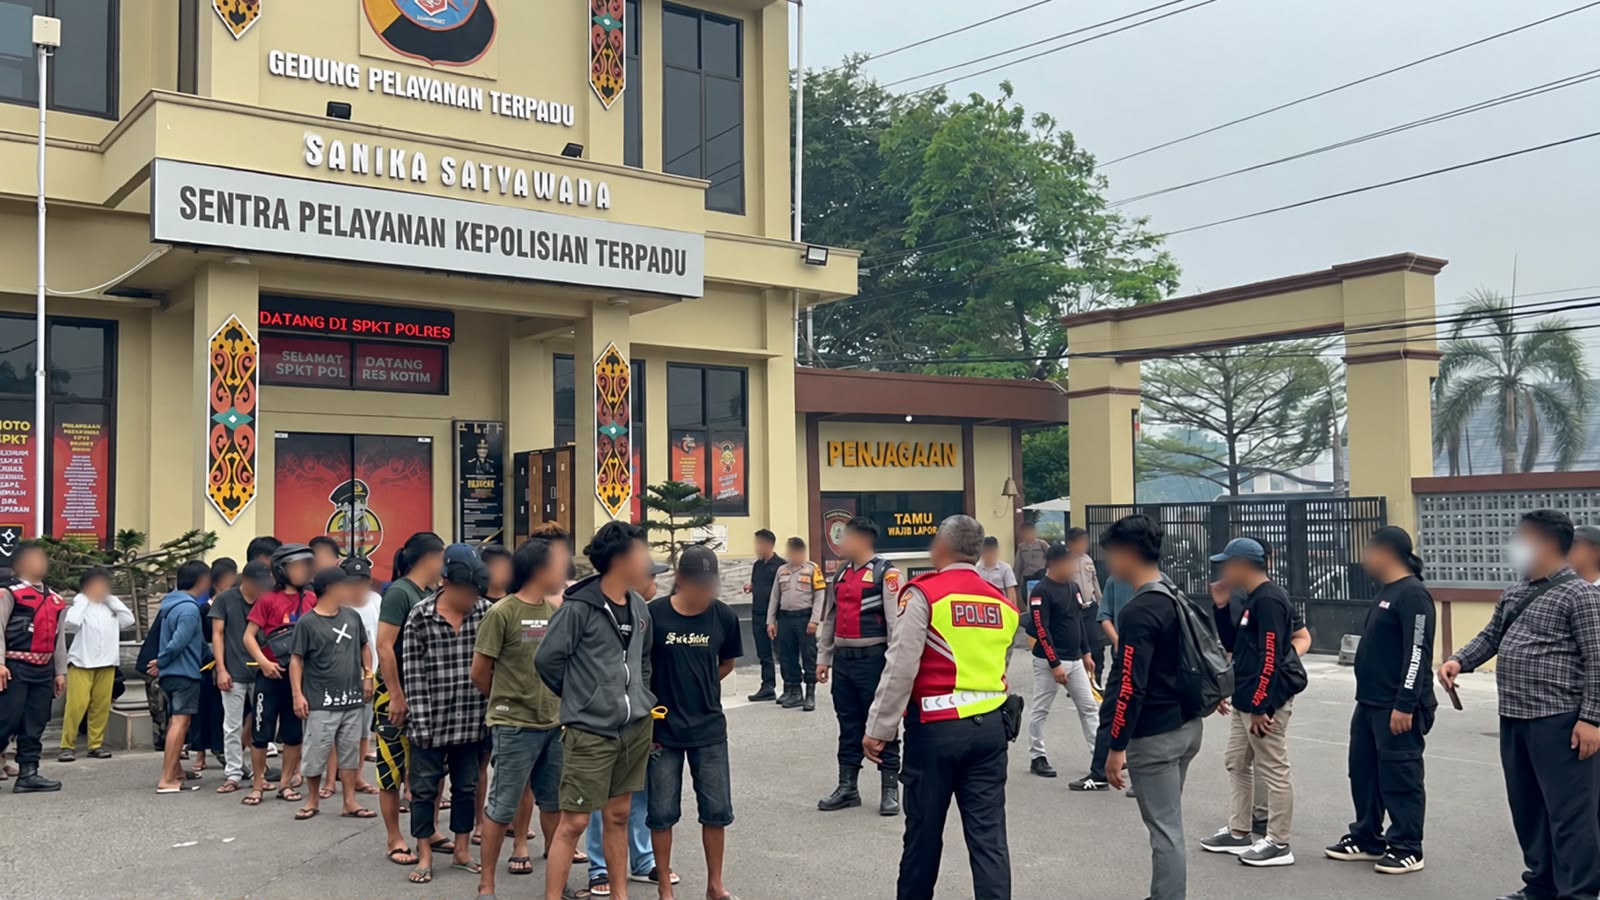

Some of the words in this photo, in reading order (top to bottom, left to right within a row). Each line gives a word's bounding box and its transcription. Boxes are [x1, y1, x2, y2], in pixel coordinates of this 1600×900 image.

[269, 50, 360, 89] GEDUNG
[368, 67, 483, 112] PELAYANAN
[489, 90, 575, 127] TERPADU
[304, 133, 428, 182] SANIKA
[441, 156, 611, 210] SATYAWADA
[180, 185, 290, 231] SENTRA
[300, 201, 446, 248] PELAYANAN
[456, 220, 589, 266] KEPOLISIAN
[595, 238, 687, 277] TERPADU
[259, 311, 325, 329] DATANG
[329, 317, 348, 331] DI
[352, 319, 391, 334] SPKT
[395, 322, 451, 339] POLRES
[282, 350, 344, 366] SELAMAT
[365, 356, 423, 370] DATANG
[276, 363, 313, 377] SPKT
[318, 365, 346, 379] POL
[362, 369, 387, 381] RES
[390, 371, 431, 383] KOTIM
[0, 420, 31, 431] OTO
[0, 434, 28, 445] PKT
[828, 440, 957, 468] PENJAGAAN
[894, 512, 933, 525] TAMU
[887, 527, 912, 536] WAJIB
[914, 526, 939, 535] LAPOR
[954, 604, 1001, 625] POLISI
